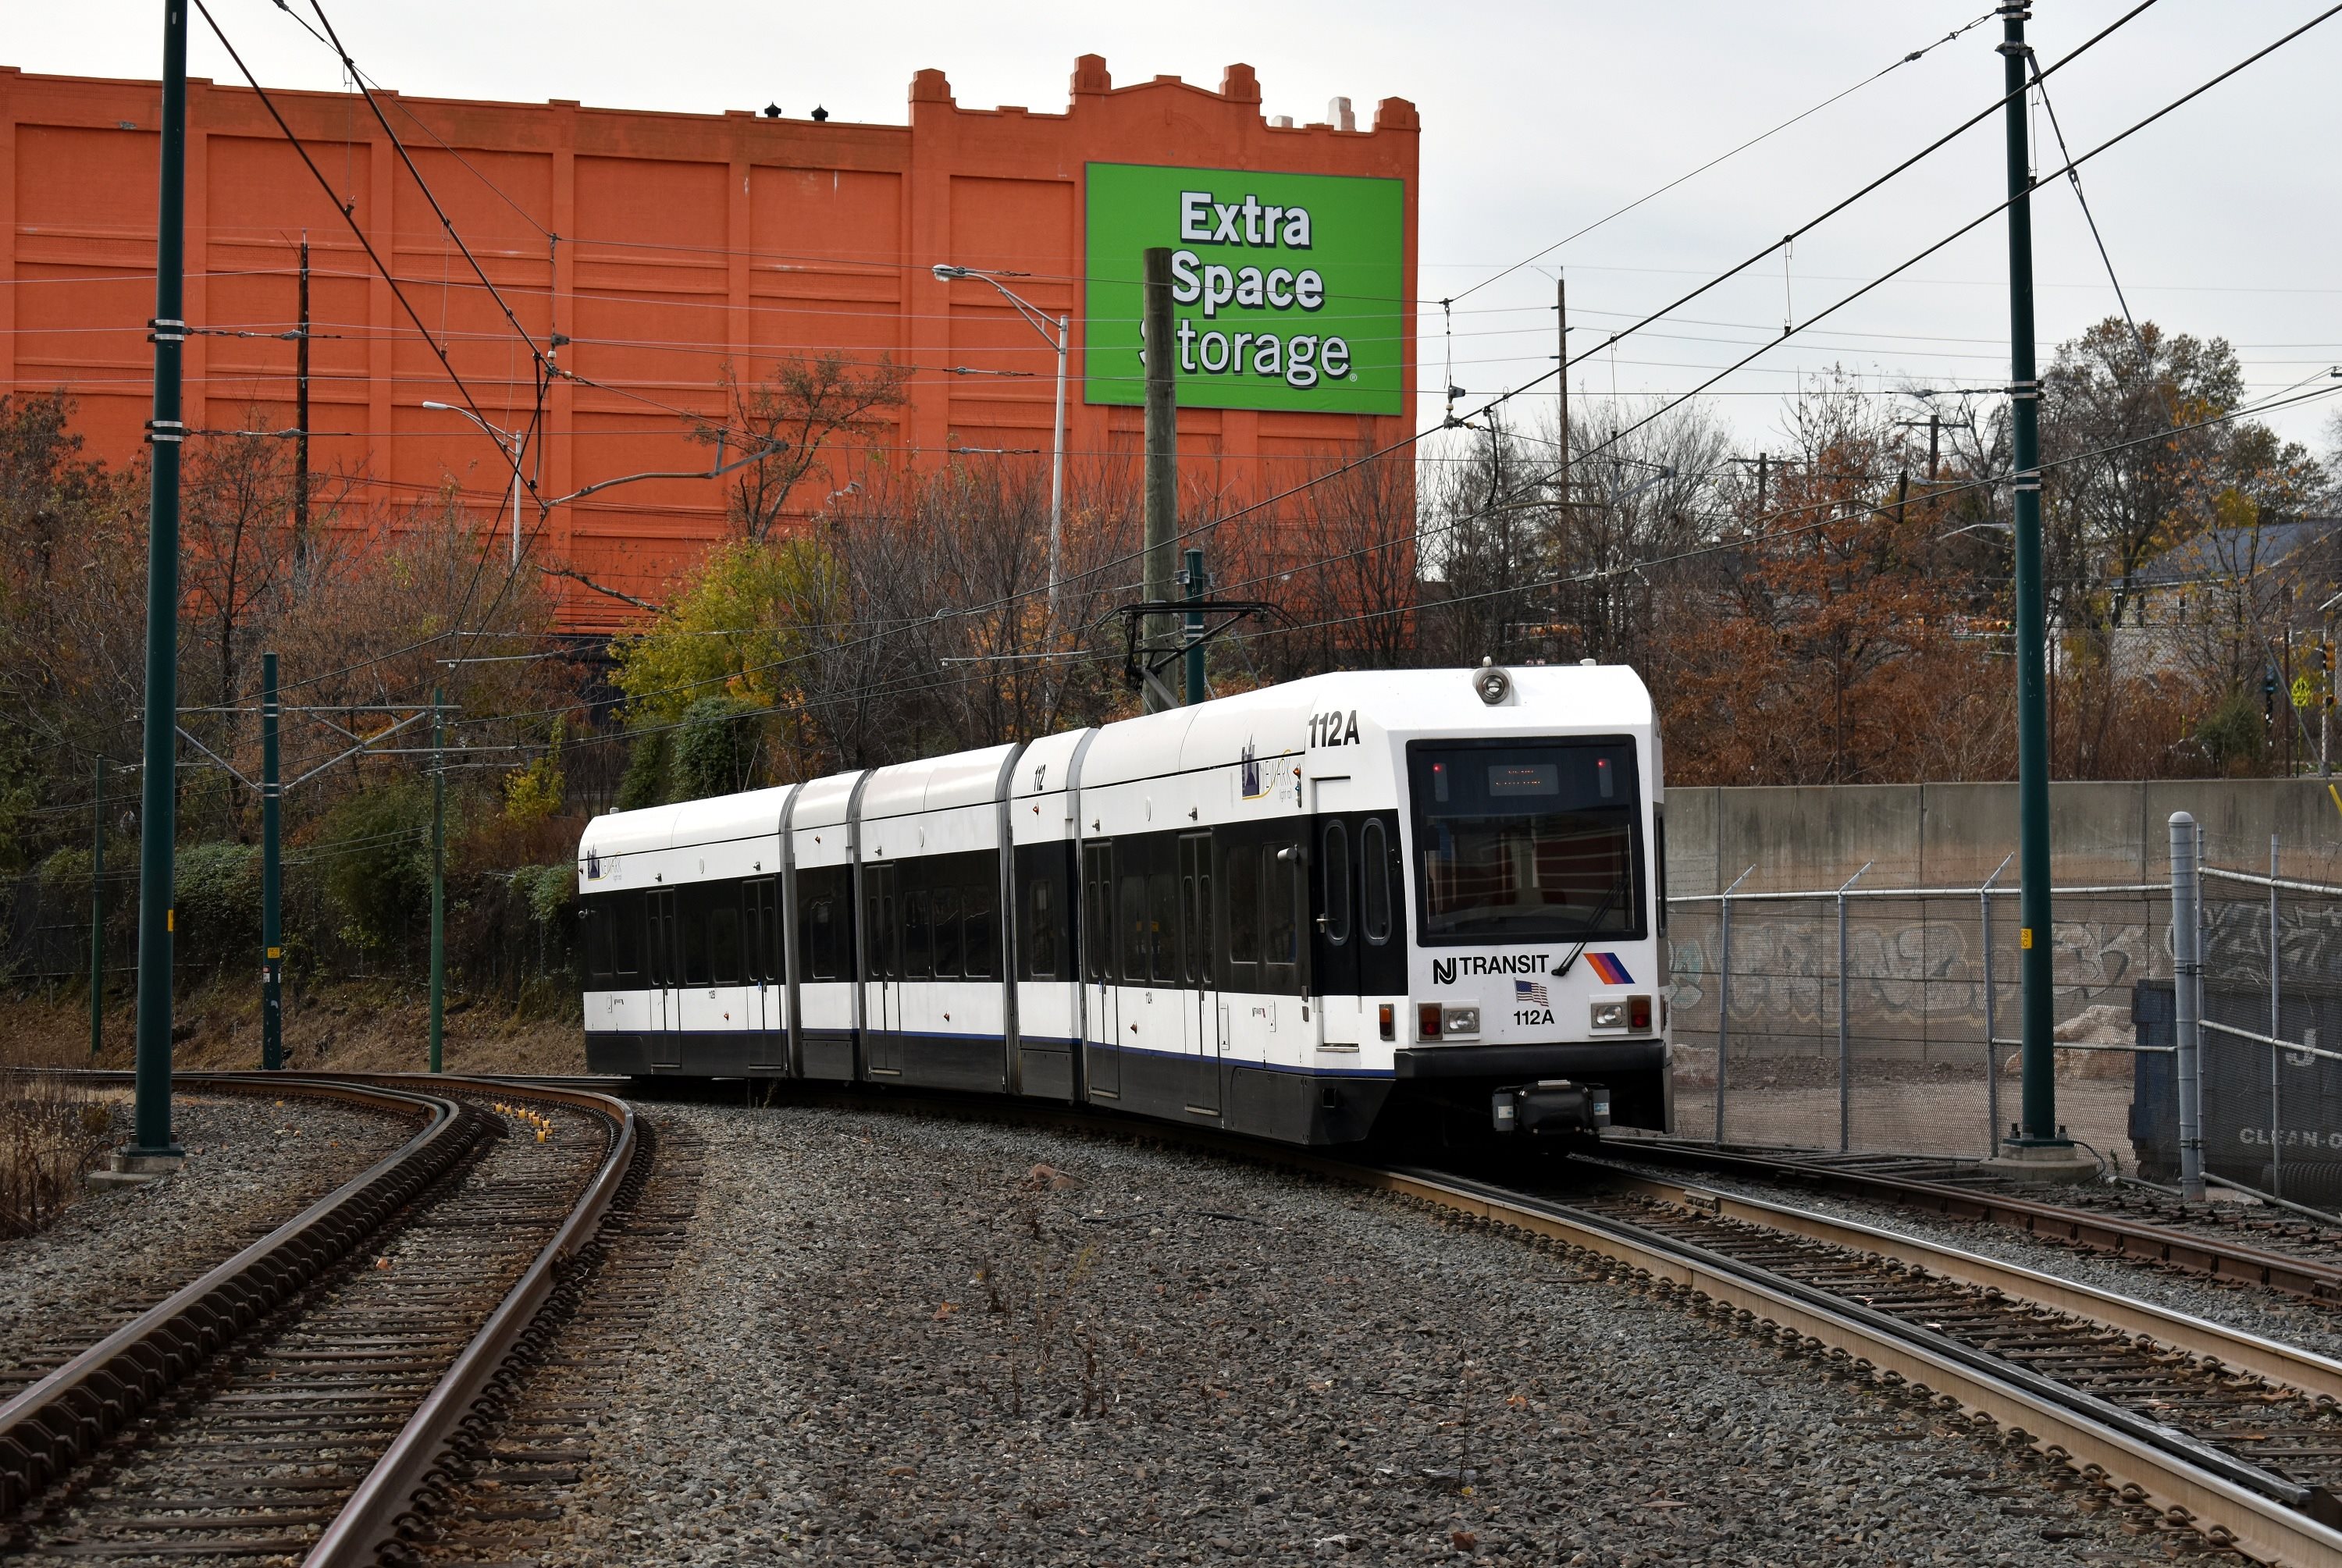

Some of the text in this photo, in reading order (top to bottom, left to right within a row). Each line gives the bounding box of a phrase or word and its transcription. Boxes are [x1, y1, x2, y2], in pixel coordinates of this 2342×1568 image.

[1180, 190, 1312, 250] Extra
[1172, 249, 1325, 318] Space
[1138, 318, 1352, 389] torage
[1308, 709, 1361, 748] 112A
[1034, 764, 1046, 791] 112
[1433, 954, 1550, 985] NJ TRANSIT
[1514, 1009, 1555, 1026] 112A
